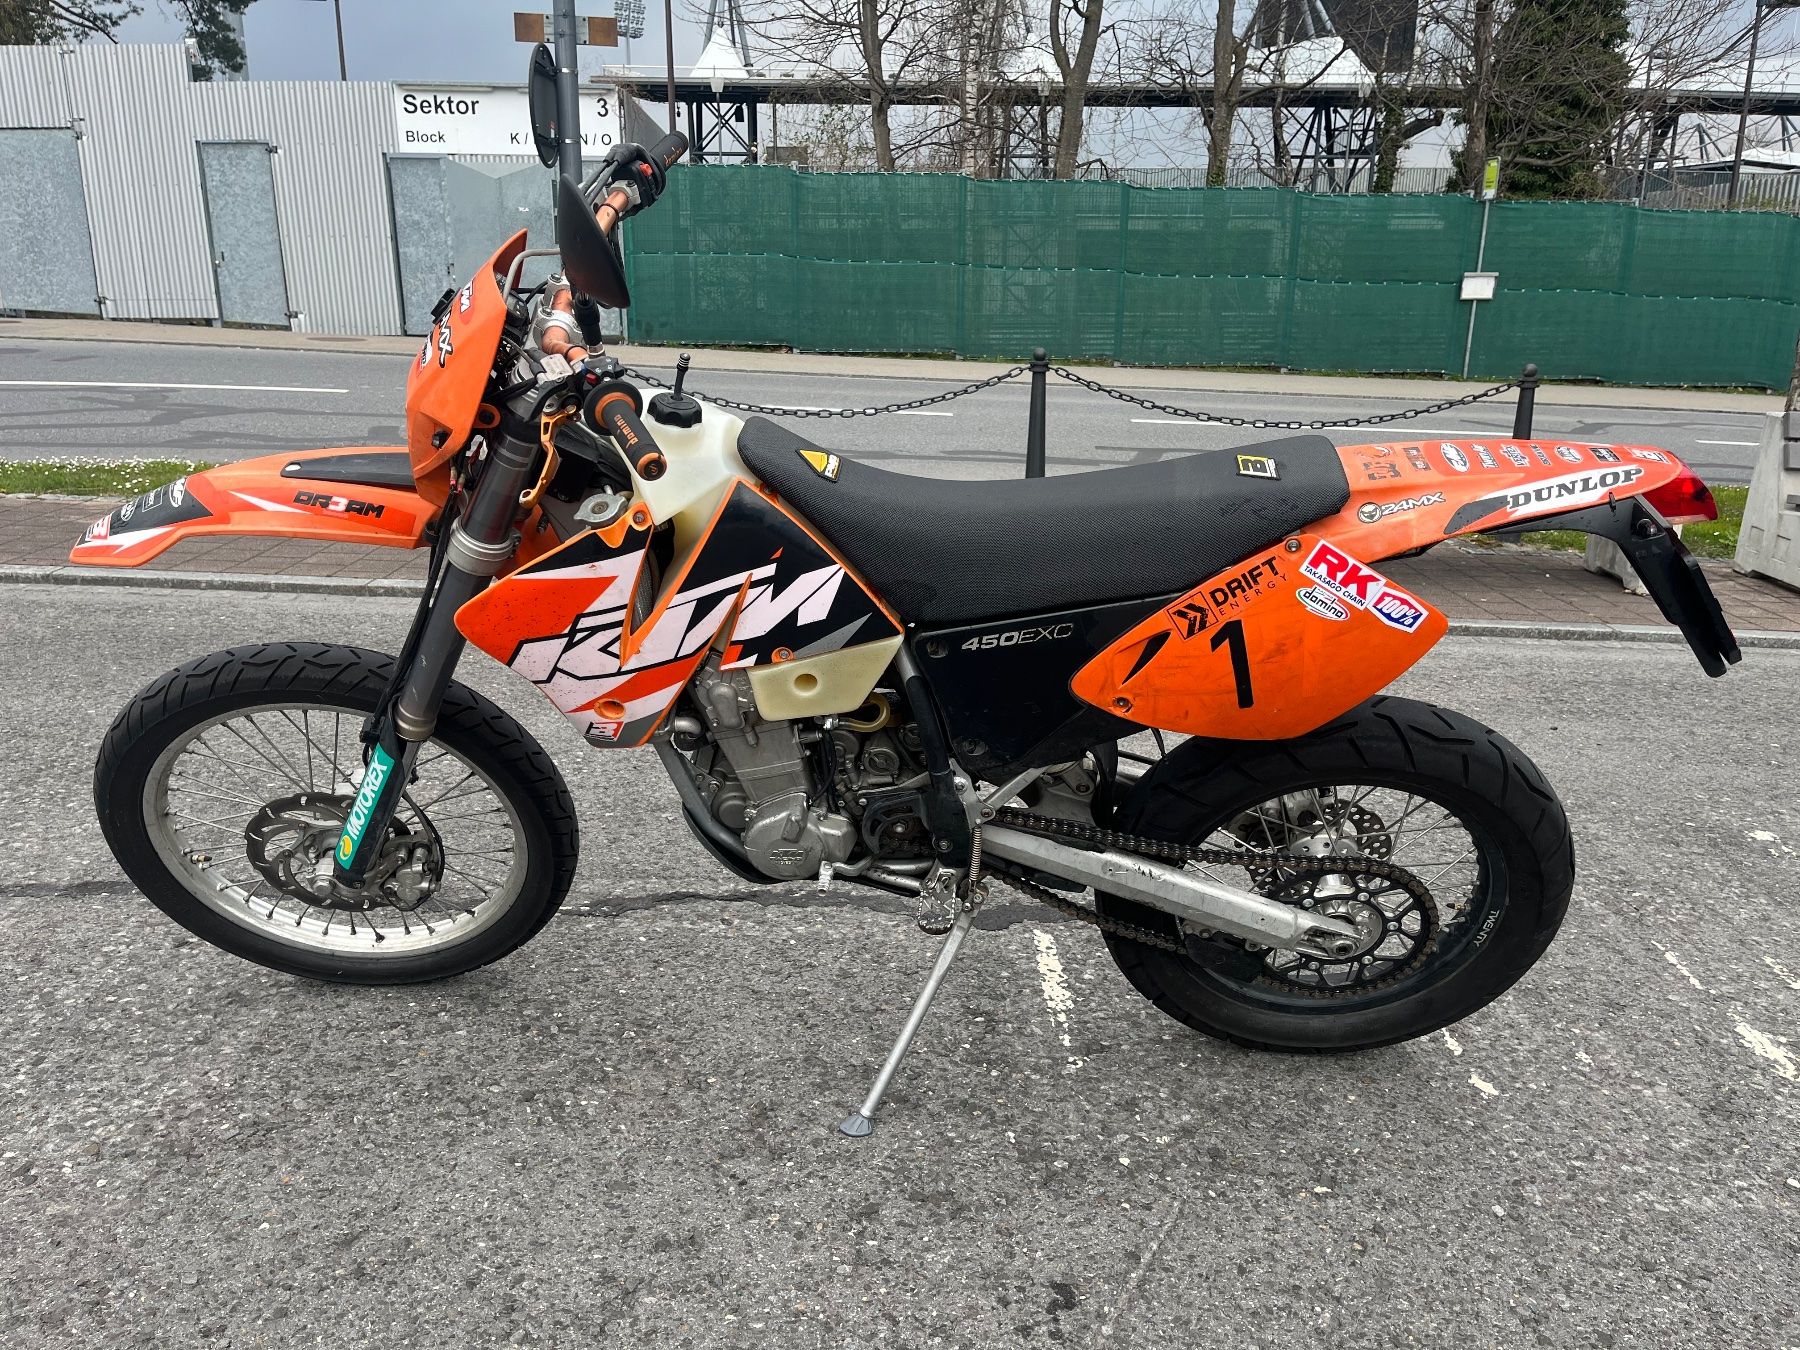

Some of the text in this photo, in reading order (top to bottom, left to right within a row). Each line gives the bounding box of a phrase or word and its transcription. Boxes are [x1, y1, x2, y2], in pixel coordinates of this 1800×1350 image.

[403, 93, 609, 118] Sektor 3
[405, 130, 446, 143] Block
[293, 490, 385, 519] DR3AM
[1381, 492, 1446, 516] 24MX
[1508, 468, 1643, 510] DUNLOP
[1208, 555, 1279, 608] DRIFT
[1303, 566, 1342, 593] TAKASAGO
[1342, 590, 1366, 607] CHAIN
[1307, 543, 1382, 601] RK
[1218, 573, 1288, 616] ENERGY
[1302, 586, 1344, 618] domino
[1376, 596, 1421, 625] 100%
[507, 562, 846, 684] KTM
[961, 623, 1074, 651] 450EXC
[1210, 619, 1255, 709] 1
[346, 751, 388, 841] MOTOREX
[1473, 909, 1500, 948] TWENTY
